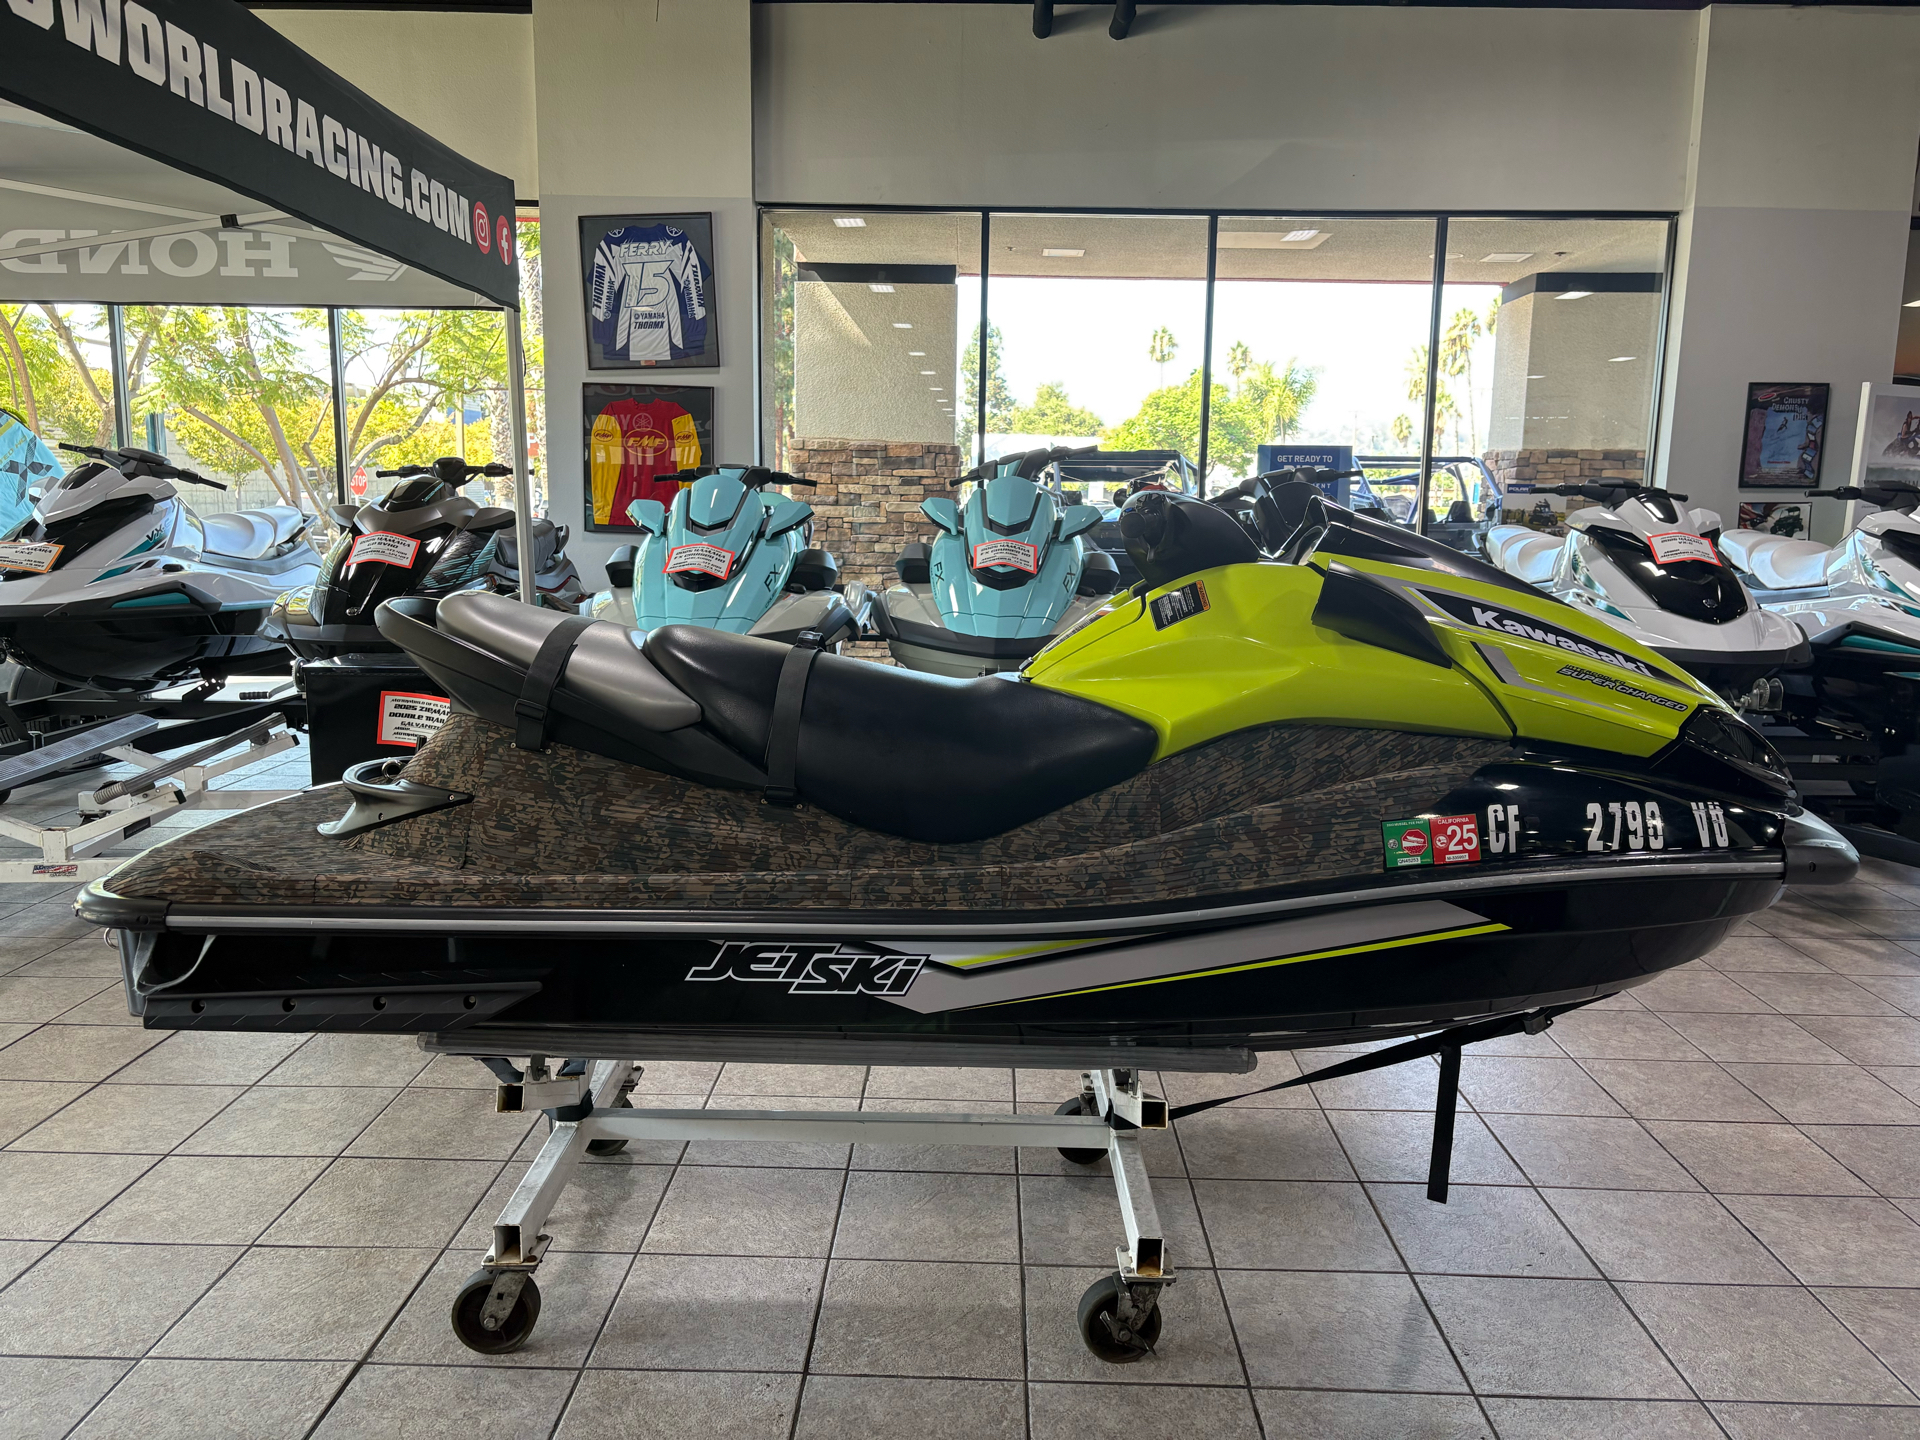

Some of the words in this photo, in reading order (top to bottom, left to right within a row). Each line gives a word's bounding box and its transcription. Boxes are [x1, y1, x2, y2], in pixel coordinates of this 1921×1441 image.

[8, 0, 472, 245] WORLDRACING.COM
[620, 240, 674, 258] FERRY
[592, 263, 607, 309] THORMX
[604, 280, 616, 312] YAMAHA
[622, 260, 674, 308] 15
[633, 321, 666, 330] THORMX
[640, 312, 666, 320] YAMAHA
[626, 436, 665, 447] FMF
[1277, 455, 1293, 463] GET
[1294, 455, 1321, 463] READY
[1322, 455, 1333, 463] TO
[350, 475, 367, 487] STOP
[764, 563, 780, 592] FX
[934, 561, 945, 582] FX
[1062, 564, 1075, 593] FX
[1472, 606, 1654, 677] Kawasaki
[1558, 667, 1616, 690] SUPER
[1616, 684, 1688, 713] CHARGED
[388, 711, 424, 721] DOUBLE
[393, 703, 418, 711] 2025
[1437, 817, 1469, 825] CALIFORNIA
[1488, 804, 1520, 853] CF
[1447, 824, 1478, 851] 25
